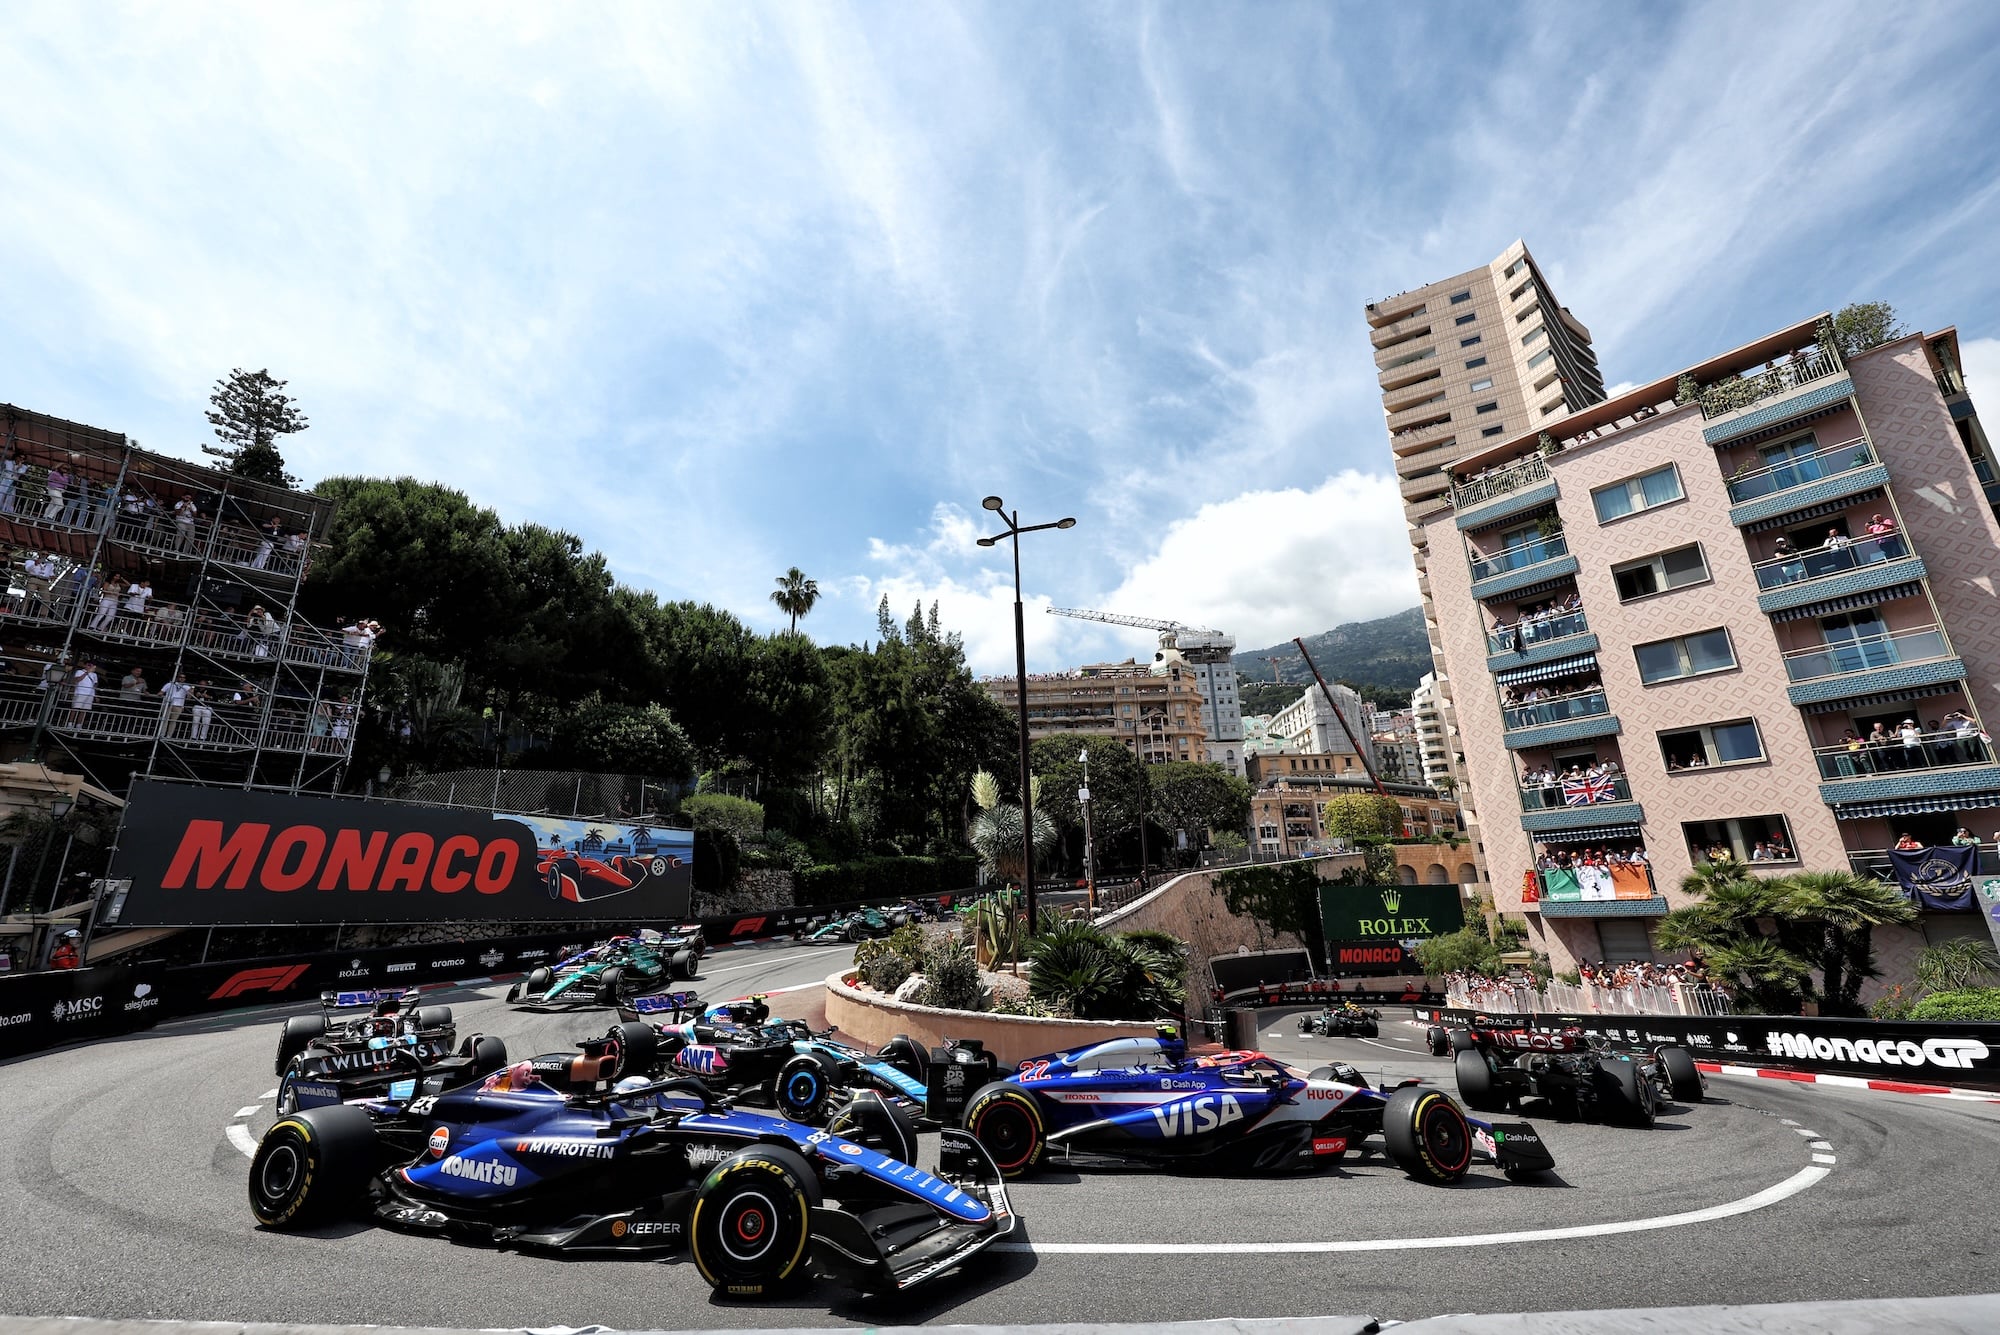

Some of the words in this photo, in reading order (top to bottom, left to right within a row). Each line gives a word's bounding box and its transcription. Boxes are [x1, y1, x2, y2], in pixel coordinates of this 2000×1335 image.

[160, 819, 519, 894] MONACO
[1359, 918, 1432, 935] ROLEX
[1340, 948, 1402, 963] MONACO
[387, 963, 416, 973] PIRELLI
[432, 959, 465, 968] aramco
[339, 968, 369, 978] ROLEX
[67, 996, 103, 1014] MSC
[124, 997, 159, 1011] salesforce
[1475, 1015, 1524, 1026] ORACLE
[1493, 1032, 1565, 1050] INEOS
[1693, 1034, 1711, 1044] MSC
[532, 1062, 563, 1070] DURACELL
[682, 1047, 714, 1074] BWT
[1020, 1060, 1052, 1082] 22
[297, 1085, 337, 1098] KOMATSU
[1172, 1080, 1189, 1088] Cash
[1190, 1081, 1206, 1090] App
[1307, 1089, 1344, 1100] HUGO
[409, 1096, 440, 1115] 23
[969, 1097, 990, 1129] ZERO
[1151, 1094, 1244, 1138] VISA
[429, 1136, 447, 1150] Gulf
[1505, 1133, 1522, 1141] Cash
[1523, 1134, 1538, 1143] App
[529, 1141, 615, 1159] MYPROTEIN
[440, 1155, 517, 1187] KOMATSU
[718, 1168, 729, 1182] P
[730, 1159, 785, 1175] ZERO
[627, 1222, 681, 1234] KEEPER
